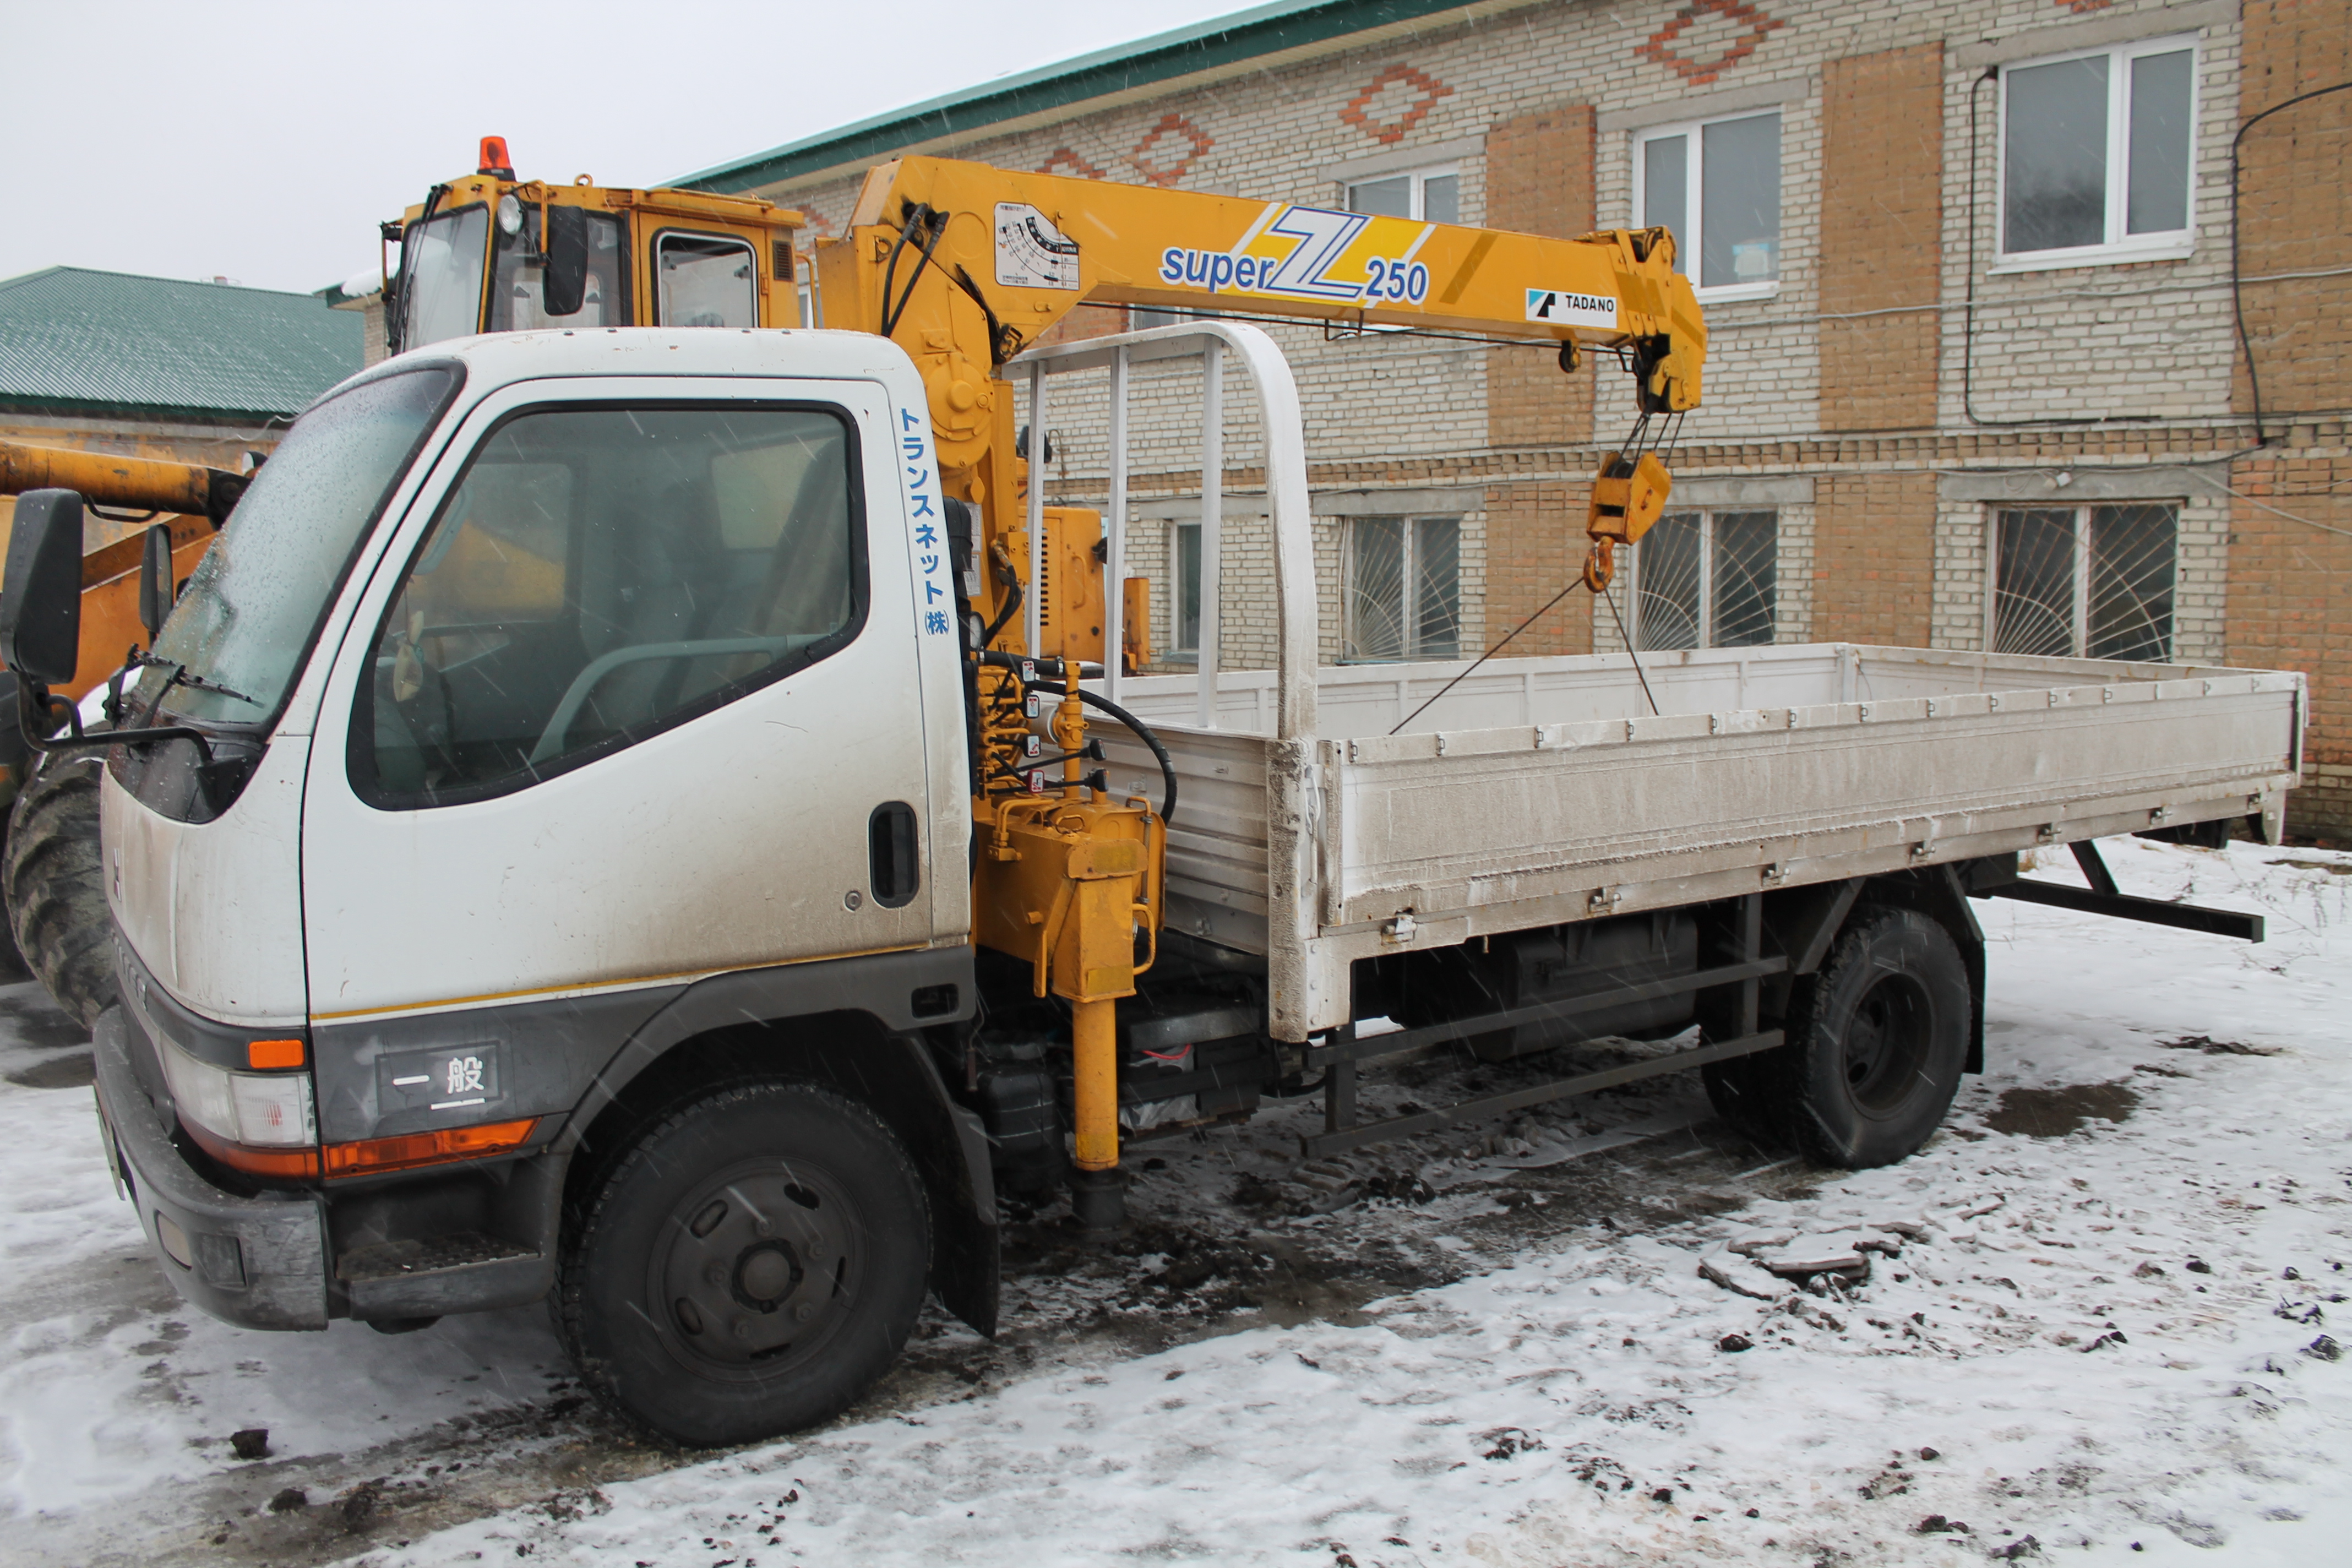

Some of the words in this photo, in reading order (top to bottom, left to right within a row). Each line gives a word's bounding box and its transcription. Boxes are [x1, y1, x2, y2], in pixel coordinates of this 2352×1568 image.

[1366, 260, 1427, 301] 250
[1566, 295, 1614, 312] TADANO
[392, 1055, 485, 1095] 一般
